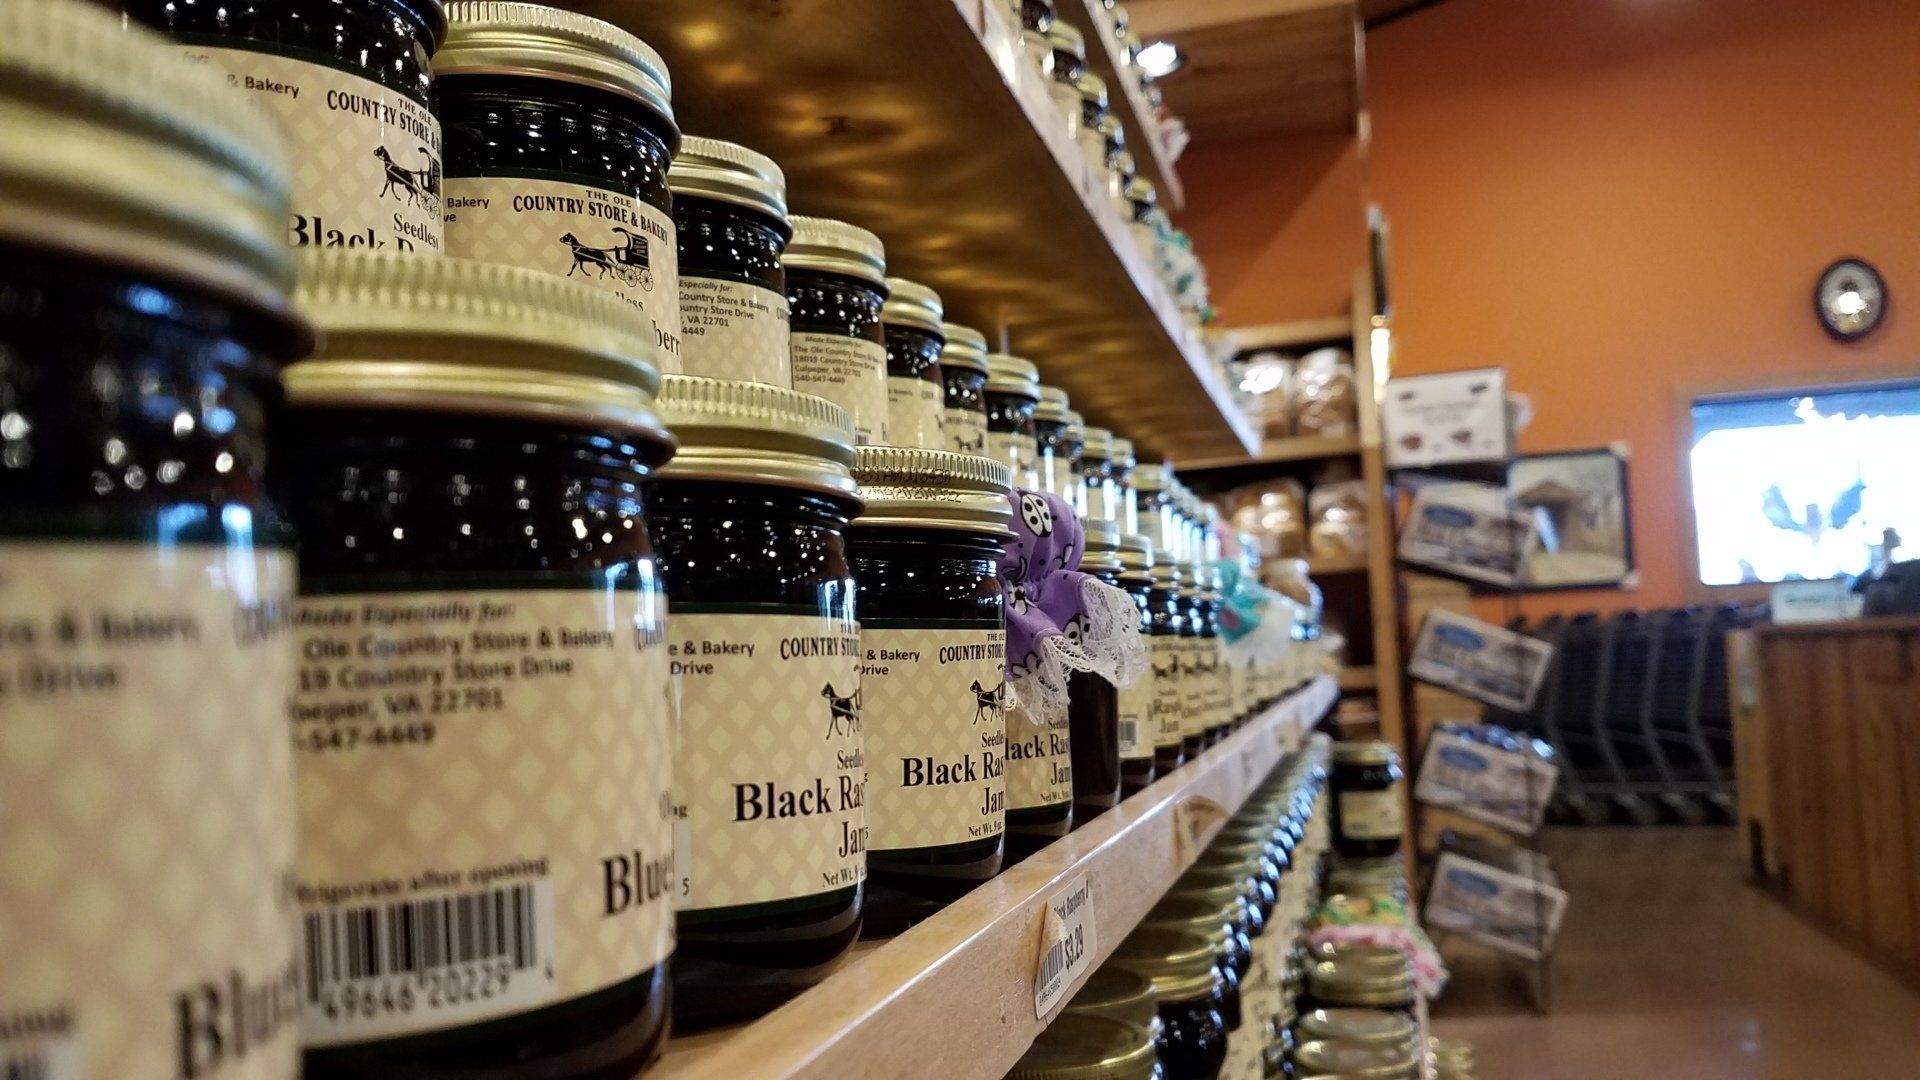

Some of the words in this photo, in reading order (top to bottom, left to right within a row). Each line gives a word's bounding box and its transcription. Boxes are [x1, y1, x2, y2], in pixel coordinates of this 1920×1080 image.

[244, 75, 300, 99] Bakery
[327, 89, 398, 126] COUNTRY
[399, 111, 431, 145] STORE
[398, 97, 417, 116] THE
[418, 109, 433, 126] OLE
[447, 196, 489, 210] Bakery
[586, 189, 609, 201] THE
[613, 196, 632, 208] OLE
[393, 212, 440, 249] Seedless
[513, 194, 585, 215] COUNTRY
[588, 200, 628, 225] STORE
[631, 211, 639, 227] &
[640, 215, 669, 247] BAKERY
[679, 290, 715, 304] Country
[717, 294, 738, 305] Store
[740, 297, 747, 307] &
[748, 299, 769, 313] Bakery
[687, 315, 701, 325] VA
[702, 316, 729, 327] 22701
[710, 305, 732, 317] Store
[734, 309, 755, 320] Drive
[683, 640, 697, 655] &
[702, 639, 755, 657] Bakery
[987, 633, 998, 642] THE
[780, 636, 839, 661] COUNTRY
[866, 649, 877, 661] &
[880, 649, 920, 662] Bakery
[939, 645, 986, 664] COUNTRY
[670, 661, 714, 676] Drive
[1005, 735, 1045, 761] lack
[900, 753, 977, 787] Black
[732, 777, 832, 822] Black
[968, 826, 981, 838] Net
[823, 871, 839, 888] Net
[1065, 923, 1084, 971] $3.29
